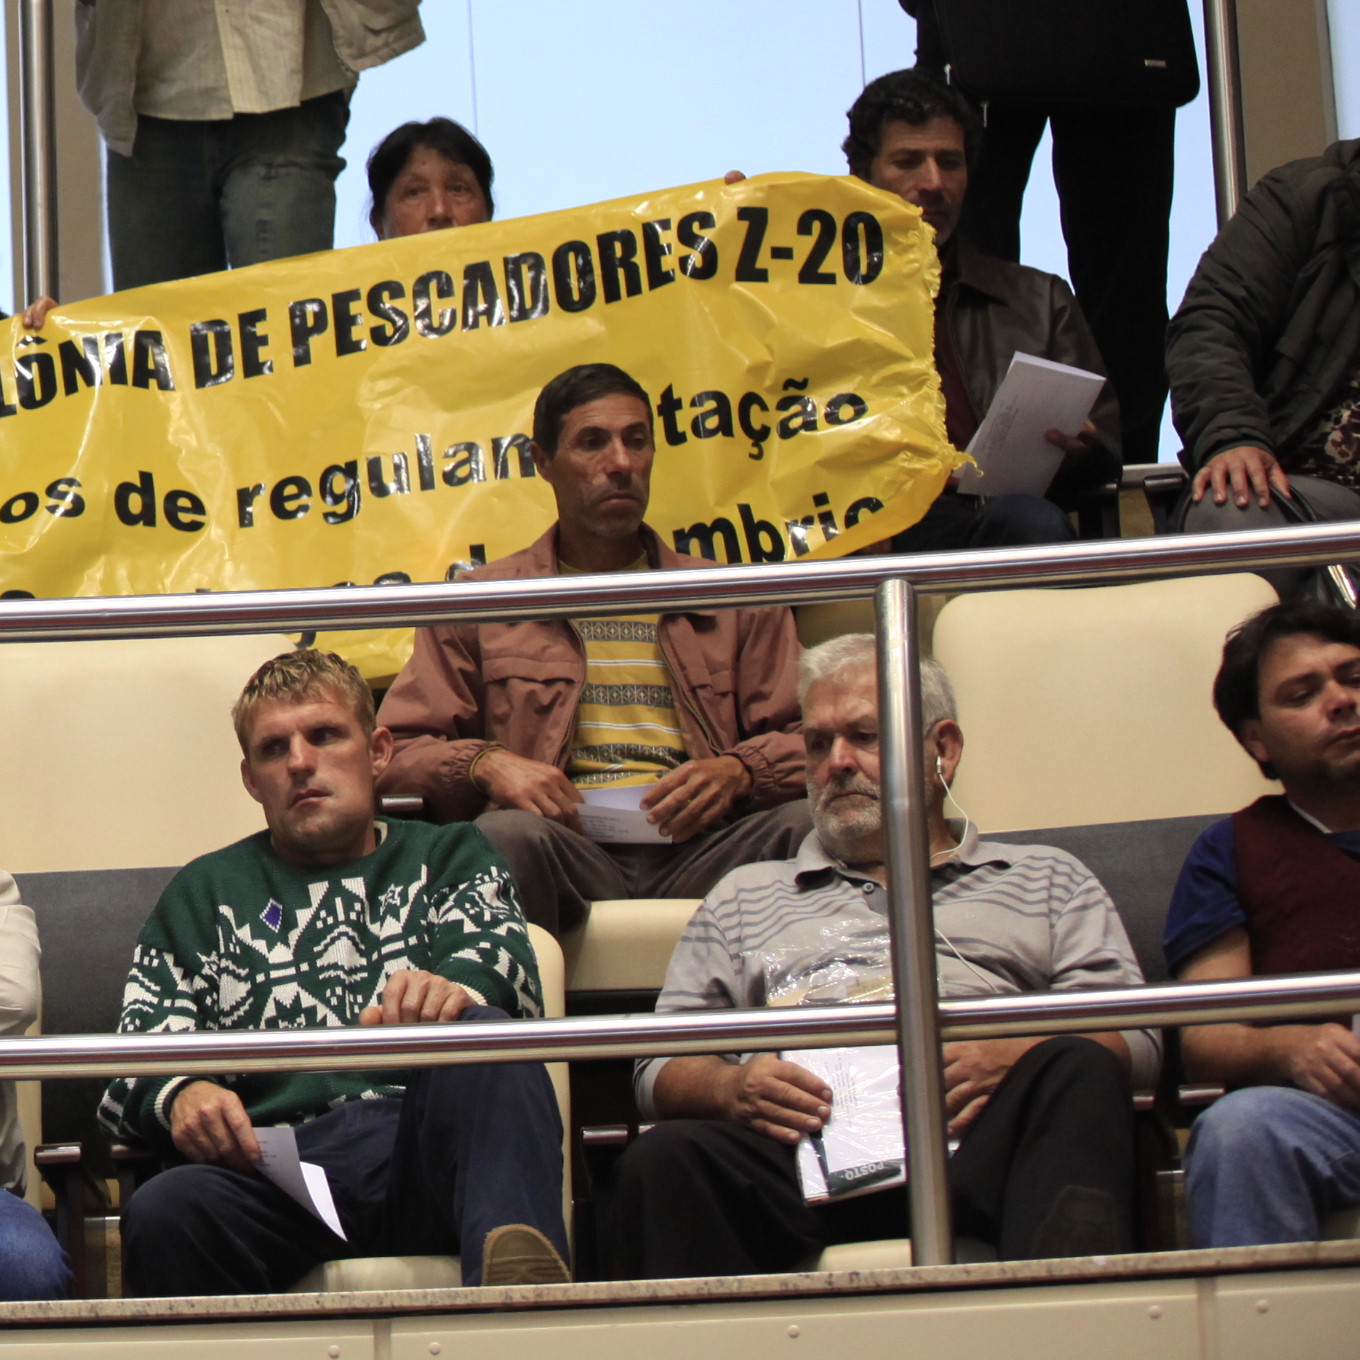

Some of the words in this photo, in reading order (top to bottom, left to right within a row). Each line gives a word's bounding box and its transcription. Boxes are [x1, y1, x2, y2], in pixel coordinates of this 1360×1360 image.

[189, 307, 274, 389] DE
[288, 210, 718, 368] PESCADORES
[735, 206, 883, 286] Z-20
[114, 470, 207, 533] de
[236, 377, 869, 528] regulamtação
